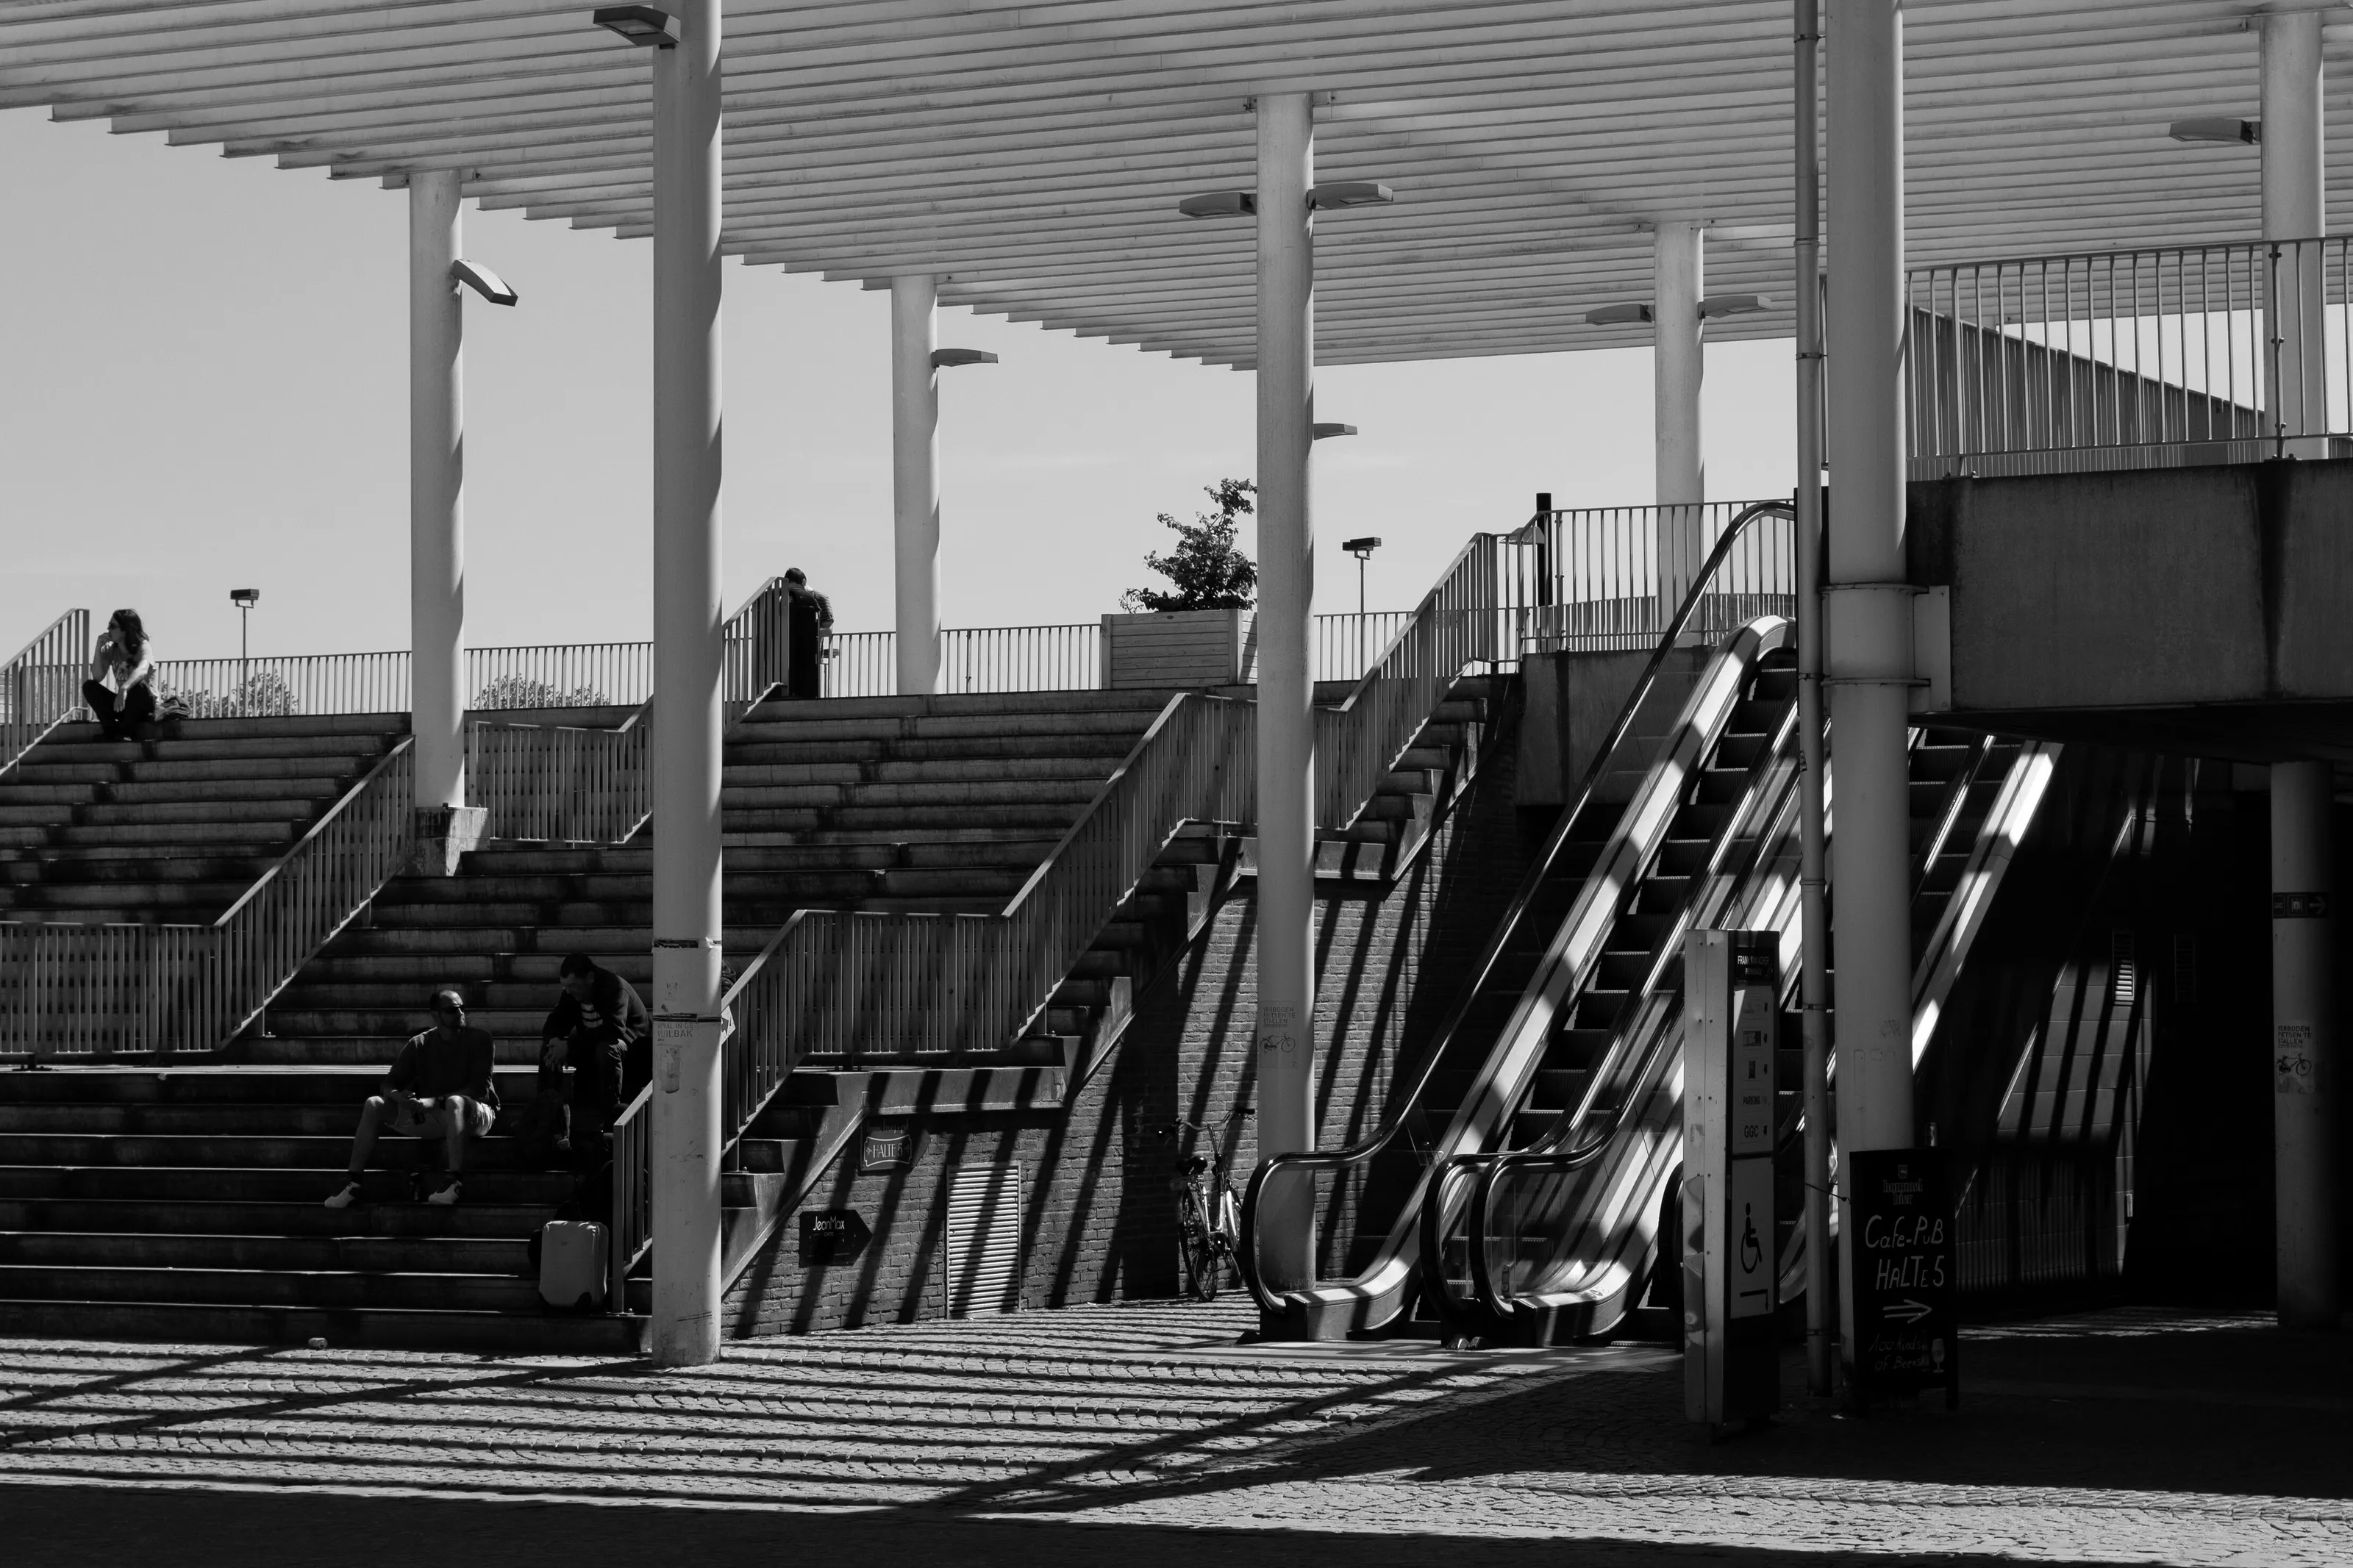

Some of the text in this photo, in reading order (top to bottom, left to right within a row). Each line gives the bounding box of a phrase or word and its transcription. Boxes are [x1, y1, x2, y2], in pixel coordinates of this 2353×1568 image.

[1743, 1095, 1760, 1106] PARKING
[1744, 1125, 1759, 1138] GGC
[873, 1142, 903, 1159] HALTE 5
[1932, 1255, 1945, 1287] 5
